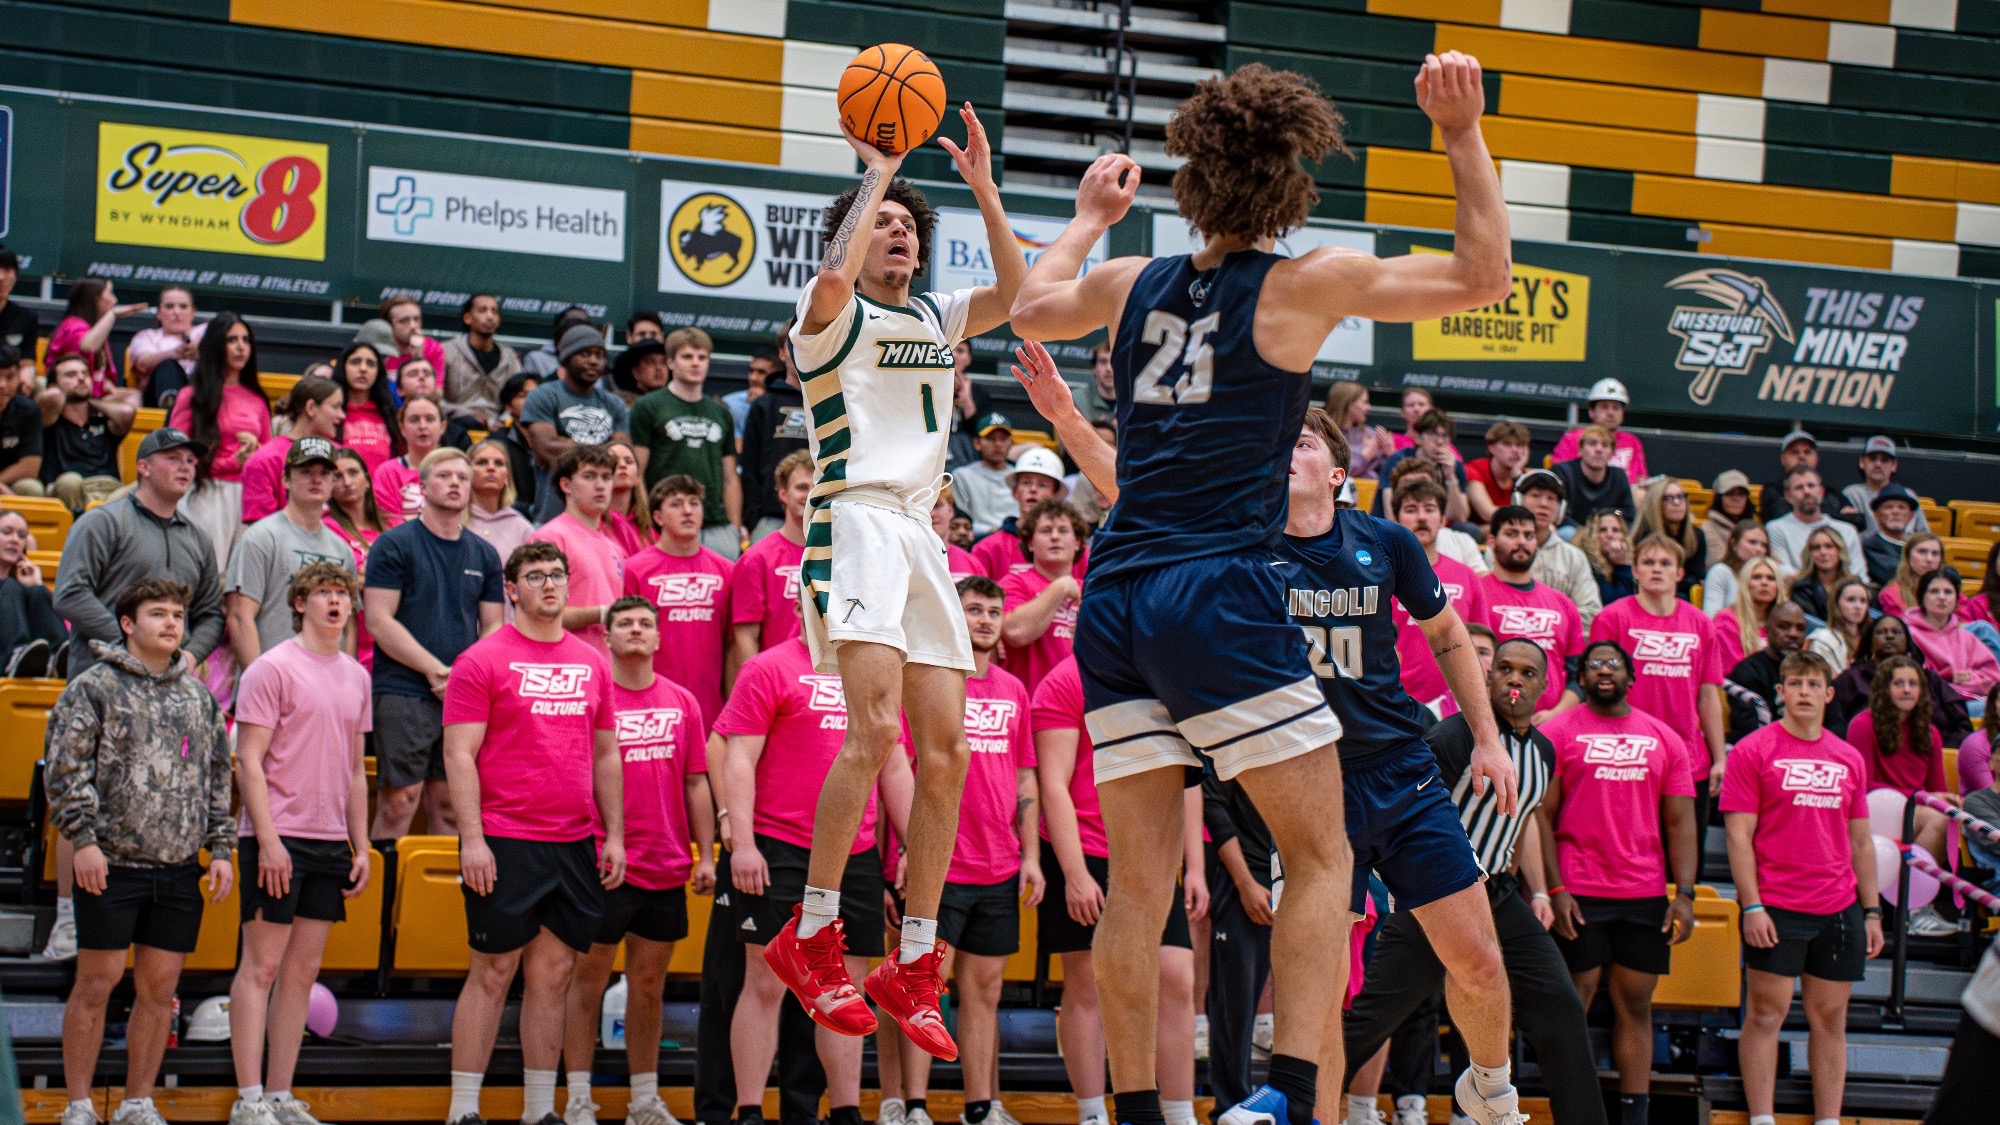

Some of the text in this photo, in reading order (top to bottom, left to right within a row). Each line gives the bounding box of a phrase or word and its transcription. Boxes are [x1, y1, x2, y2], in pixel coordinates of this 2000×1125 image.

[106, 140, 322, 245] Super 8
[110, 209, 230, 231] BY WYNDHAM
[445, 197, 618, 237] Phelps Health
[766, 204, 822, 227] BUFF
[87, 262, 330, 294] PROUD SPONSOR OF MINER ATHLETICS
[695, 314, 751, 331] SPONSOR
[1674, 312, 1763, 335] MISSOURI
[1803, 287, 1925, 332] THIS IS
[1441, 315, 1556, 344] BARBECUE PIT
[881, 343, 954, 365] MINES
[1133, 310, 1221, 405] 25
[1681, 330, 1767, 368] S&T
[1793, 327, 1909, 371] MINER
[1757, 364, 1896, 410] NATION
[920, 383, 939, 433] 1
[657, 575, 721, 605] S&T
[1288, 586, 1379, 618] INCOLN
[668, 607, 714, 622] CULTURE
[1501, 609, 1560, 633] S&T
[1301, 626, 1364, 680] 20
[1634, 632, 1699, 662] S&T
[520, 664, 591, 697] S&T
[1643, 664, 1692, 677] CULTURE
[531, 701, 588, 716] CULTURE
[617, 710, 680, 742] S&T
[624, 744, 676, 763] CULTURE
[1585, 736, 1657, 764] S&T
[1594, 767, 1648, 781] CULTURE
[1784, 762, 1848, 792] S&T
